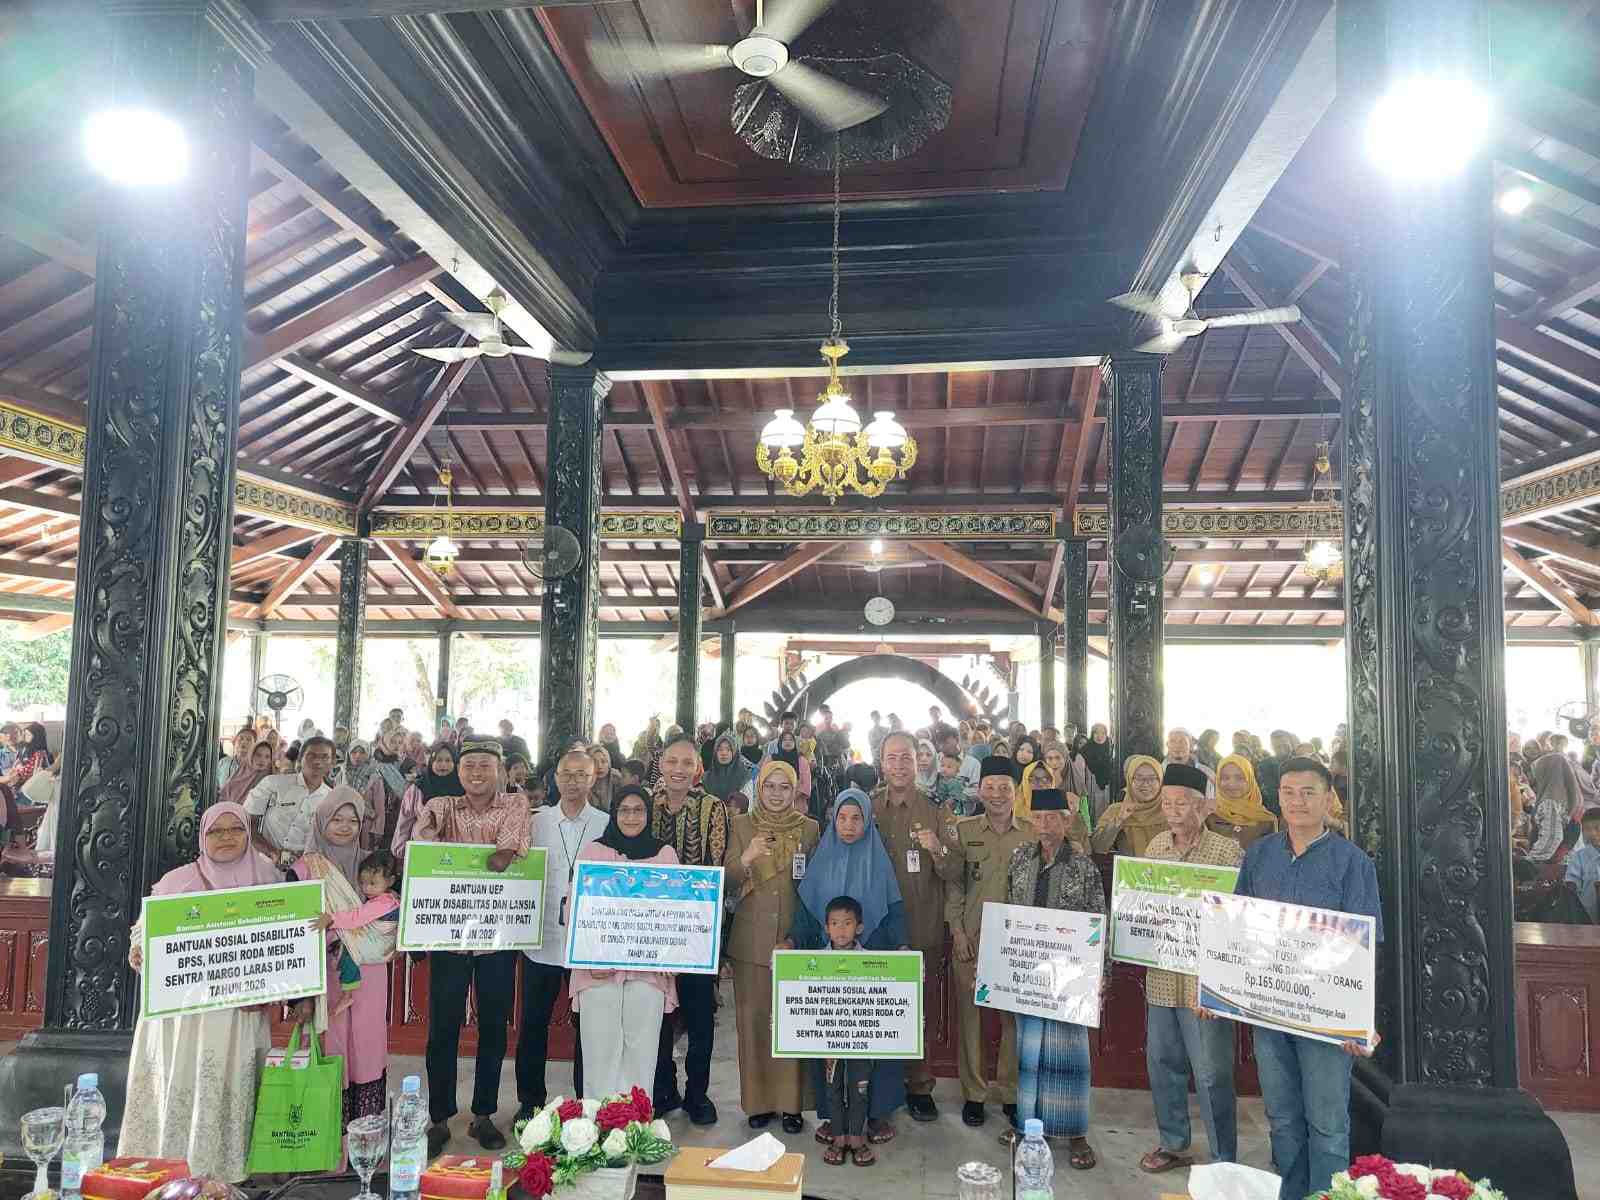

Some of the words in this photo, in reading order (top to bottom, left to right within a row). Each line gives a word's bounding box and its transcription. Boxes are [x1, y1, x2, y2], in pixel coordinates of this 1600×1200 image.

[450, 884, 487, 894] BANTUAN
[489, 885, 503, 894] UEP
[413, 899, 441, 909] UNTUK
[443, 899, 489, 909] DISABILITAS
[493, 900, 507, 909] DAN
[510, 900, 535, 910] LANSIA
[415, 914, 447, 925] SENTRA
[515, 915, 531, 924] PATI
[1130, 926, 1154, 937] SENTRA
[166, 938, 212, 954] BANTUAN
[215, 933, 248, 948] SOSIAL
[251, 926, 305, 943] DISABILITAS
[1010, 936, 1035, 947] BANTUAN
[1036, 939, 1072, 952] PERMAKANAN
[178, 956, 206, 969] BPSS,
[208, 952, 237, 965] KURSI
[240, 948, 265, 961] RODA
[267, 943, 295, 956] MEDIS
[1000, 946, 1017, 956] UNTUK
[1018, 948, 1036, 959] LANJUT
[165, 971, 203, 987] SENTRA
[207, 966, 241, 981] MARGO
[244, 963, 273, 976] LARAS
[275, 961, 285, 971] DI
[287, 957, 306, 969] PATI
[1245, 971, 1316, 999] Rp.165.000.000,-
[1328, 975, 1332, 984] 7
[1334, 977, 1363, 990] ORANG
[210, 983, 242, 997] TAHUN
[808, 986, 840, 994] BANTUAN
[843, 986, 866, 994] SOSIAL
[868, 986, 887, 994] ANAK
[786, 996, 803, 1004] BPSS
[821, 997, 874, 1005] PERLENGKAPAN
[876, 997, 910, 1007] SEKOLAH,
[859, 1020, 880, 1028] MEDIS
[796, 1030, 823, 1038] SENTRA
[885, 1031, 899, 1039] PATI
